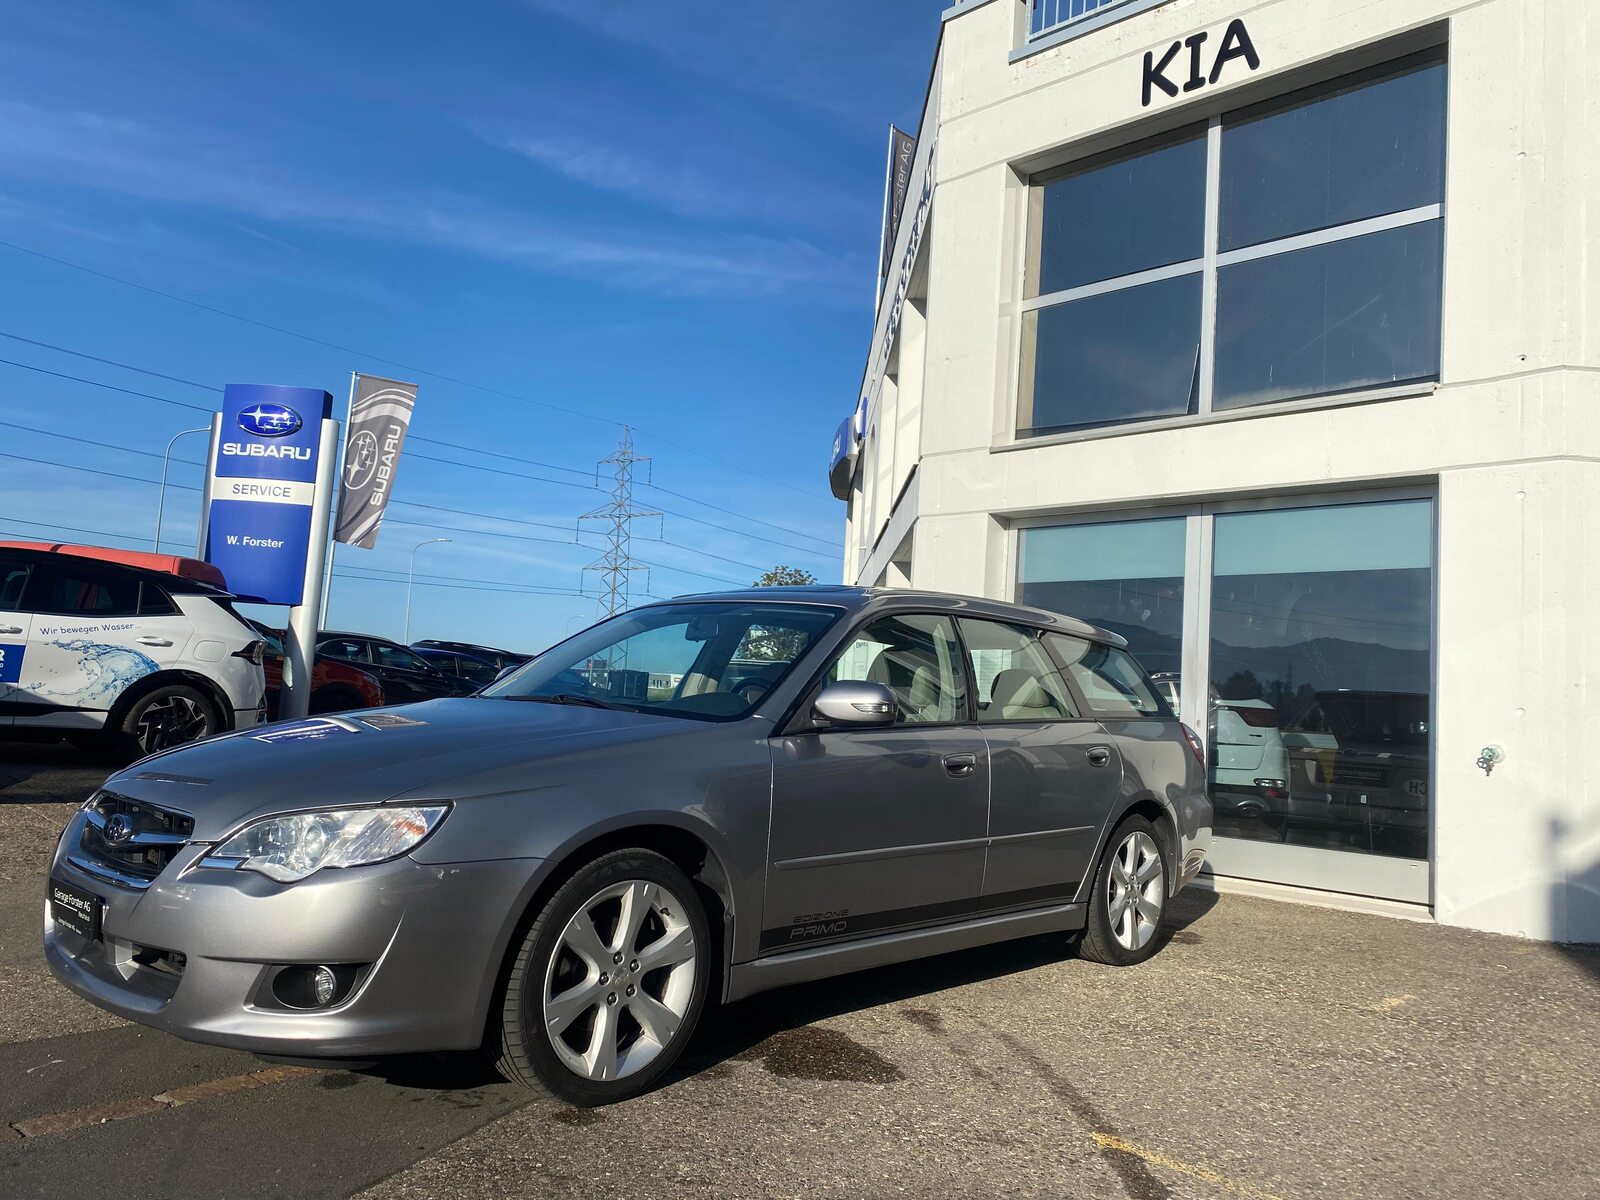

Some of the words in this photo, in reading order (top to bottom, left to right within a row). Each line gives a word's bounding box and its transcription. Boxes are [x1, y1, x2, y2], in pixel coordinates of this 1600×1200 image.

[1141, 18, 1261, 107] KIA
[901, 141, 912, 165] AG
[222, 442, 311, 460] SUBARU
[370, 424, 401, 506] SUBARU
[232, 483, 292, 498] SERVICE
[226, 535, 240, 546] W.
[243, 536, 284, 548] Forster
[40, 627, 58, 635] Wir
[60, 626, 99, 635] bewegen
[54, 888, 69, 903] Garage
[68, 894, 84, 908] Forster
[83, 900, 91, 912] AG
[793, 909, 849, 924] EDIZIONE
[790, 921, 847, 940] PRIMO
